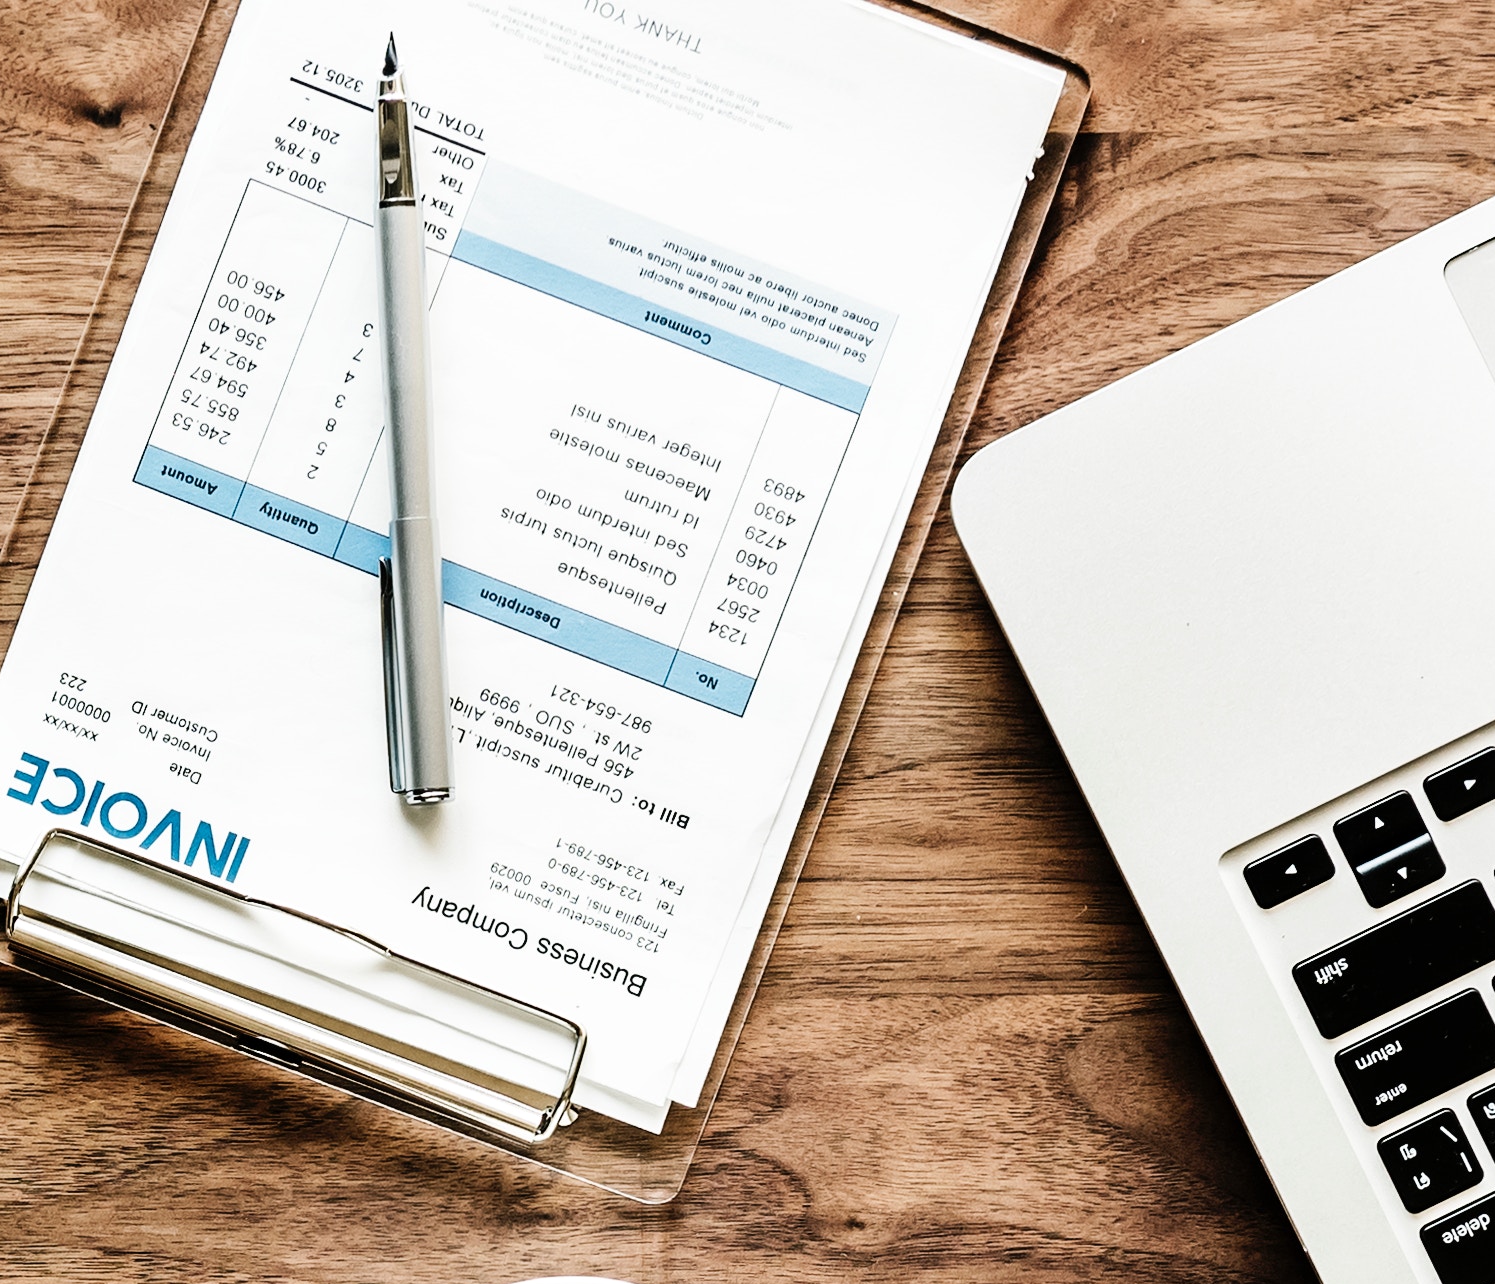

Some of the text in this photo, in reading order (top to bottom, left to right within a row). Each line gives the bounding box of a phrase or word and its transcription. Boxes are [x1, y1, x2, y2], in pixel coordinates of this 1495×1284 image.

[302, 59, 364, 93] 3205.12
[644, 310, 712, 345] Comment
[172, 412, 231, 445] 246.53
[161, 465, 218, 495] Amount
[259, 501, 319, 535] Quantity
[480, 588, 561, 629] Description
[59, 672, 87, 692] 223
[695, 671, 719, 690] No.
[51, 691, 111, 723] 0000001
[131, 700, 218, 743] Customer ID
[550, 684, 652, 734] 987-654-321
[138, 724, 211, 762] Invoice No.
[169, 762, 202, 785] Date
[5, 750, 252, 884] INVOICE
[632, 796, 690, 829] Bill to:
[410, 885, 648, 998] Business Company
[1355, 1040, 1403, 1070] return
[1442, 1214, 1490, 1244] delete
